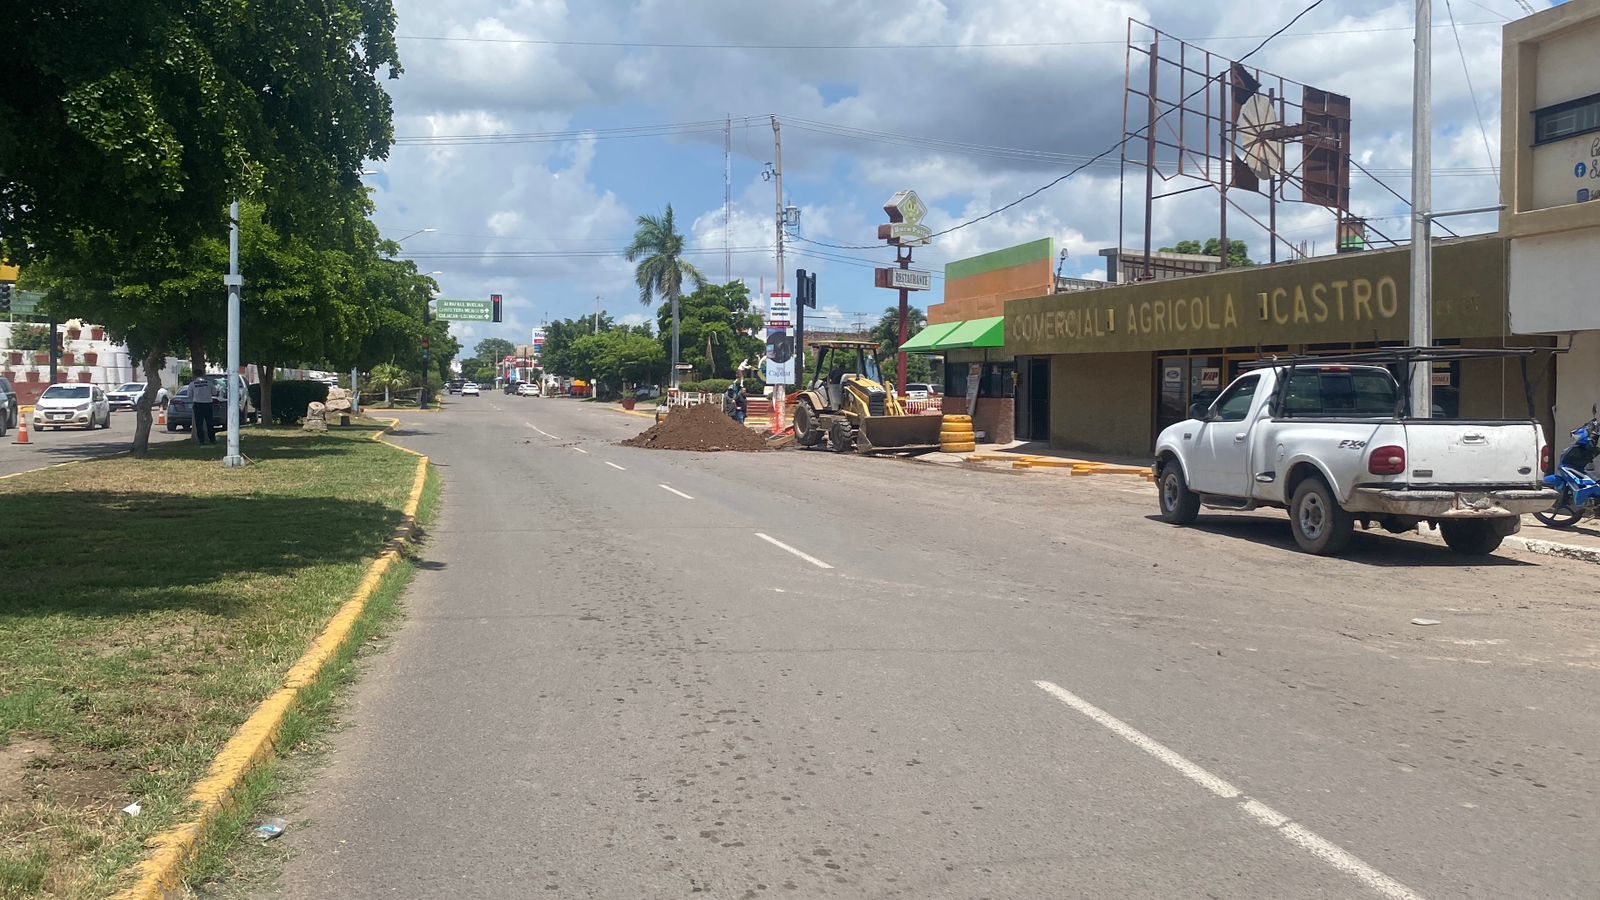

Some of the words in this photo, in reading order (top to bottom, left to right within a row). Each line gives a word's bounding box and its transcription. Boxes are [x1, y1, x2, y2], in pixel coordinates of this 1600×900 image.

[895, 272, 928, 286] RESTAURANTE
[1012, 307, 1105, 342] COMERCIAL
[1127, 293, 1238, 337] AGRICOLA
[1271, 276, 1398, 325] CASTRO
